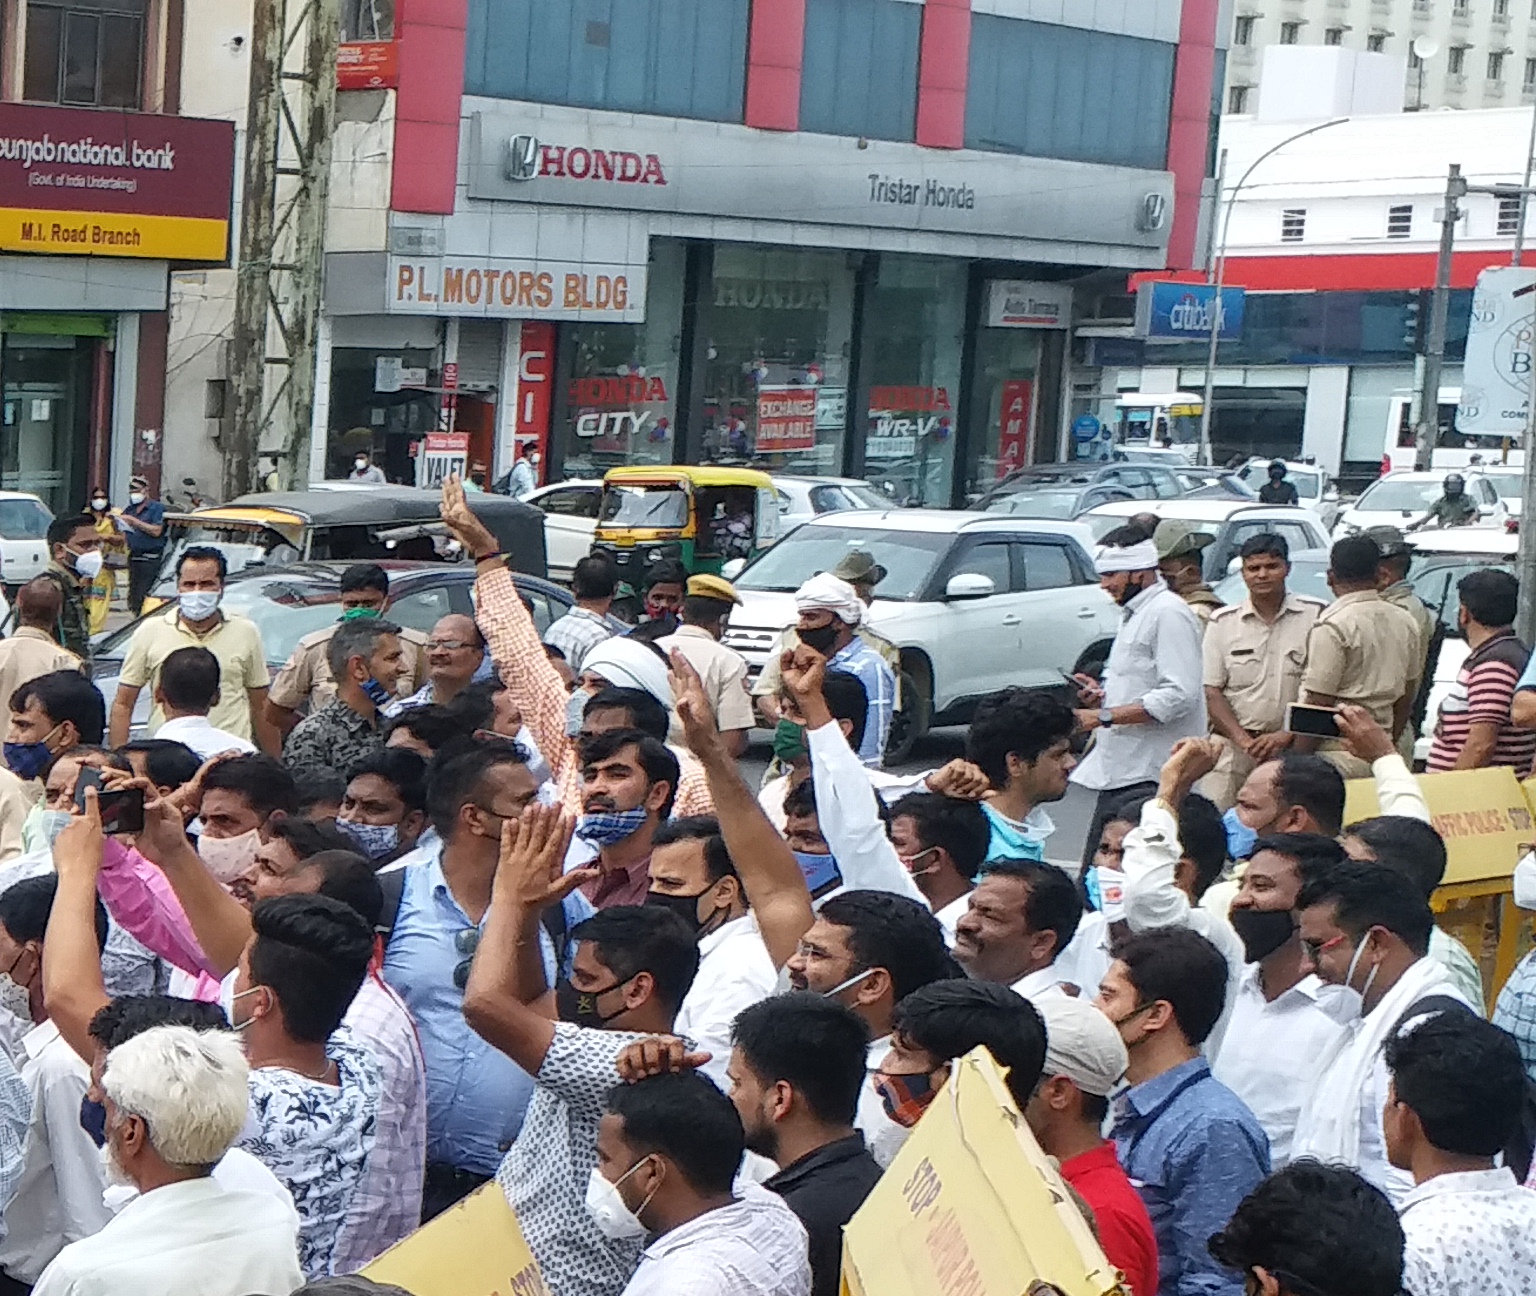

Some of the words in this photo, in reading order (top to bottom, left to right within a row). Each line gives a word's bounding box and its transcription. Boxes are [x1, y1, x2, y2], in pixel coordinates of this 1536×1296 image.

[538, 144, 668, 186] HONDA
[868, 174, 920, 205] Tristar
[925, 178, 975, 210] Honda
[20, 222, 46, 242] M.I.
[51, 224, 88, 243] Road
[92, 226, 142, 246] Branch
[397, 264, 439, 302] P.L.
[443, 267, 554, 308] MOTORS
[563, 273, 635, 311] BLDG.
[567, 376, 669, 406] HONDA
[760, 401, 816, 418] EXCHANGE
[576, 411, 652, 437] CITY
[758, 422, 813, 440] AVAILABLE
[877, 415, 937, 437] WR-V
[902, 1156, 942, 1219] STOP
